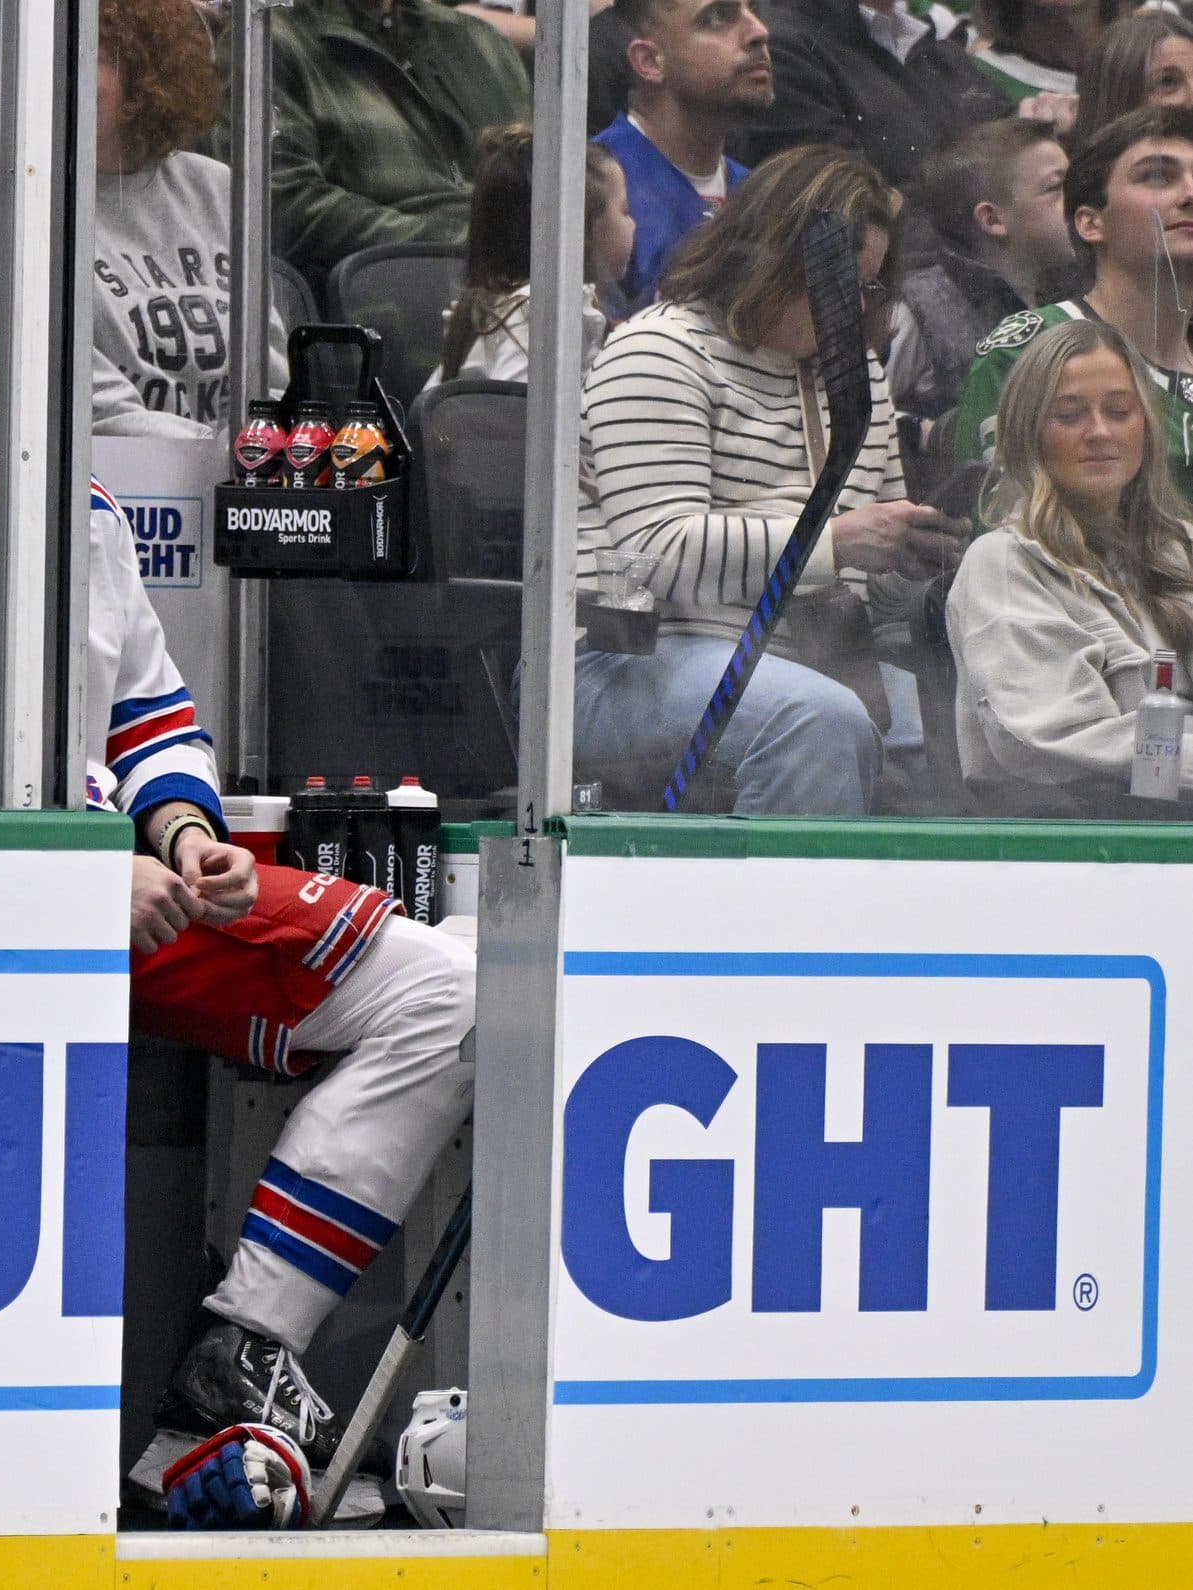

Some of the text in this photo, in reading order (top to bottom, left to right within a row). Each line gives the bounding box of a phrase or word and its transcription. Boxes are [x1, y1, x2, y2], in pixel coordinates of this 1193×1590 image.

[128, 294, 230, 371] 199
[227, 507, 332, 533] BODYARMOR
[278, 533, 332, 545] Sports Drink
[375, 501, 385, 559] BODYARMOR
[560, 1035, 1106, 1323] GHT
